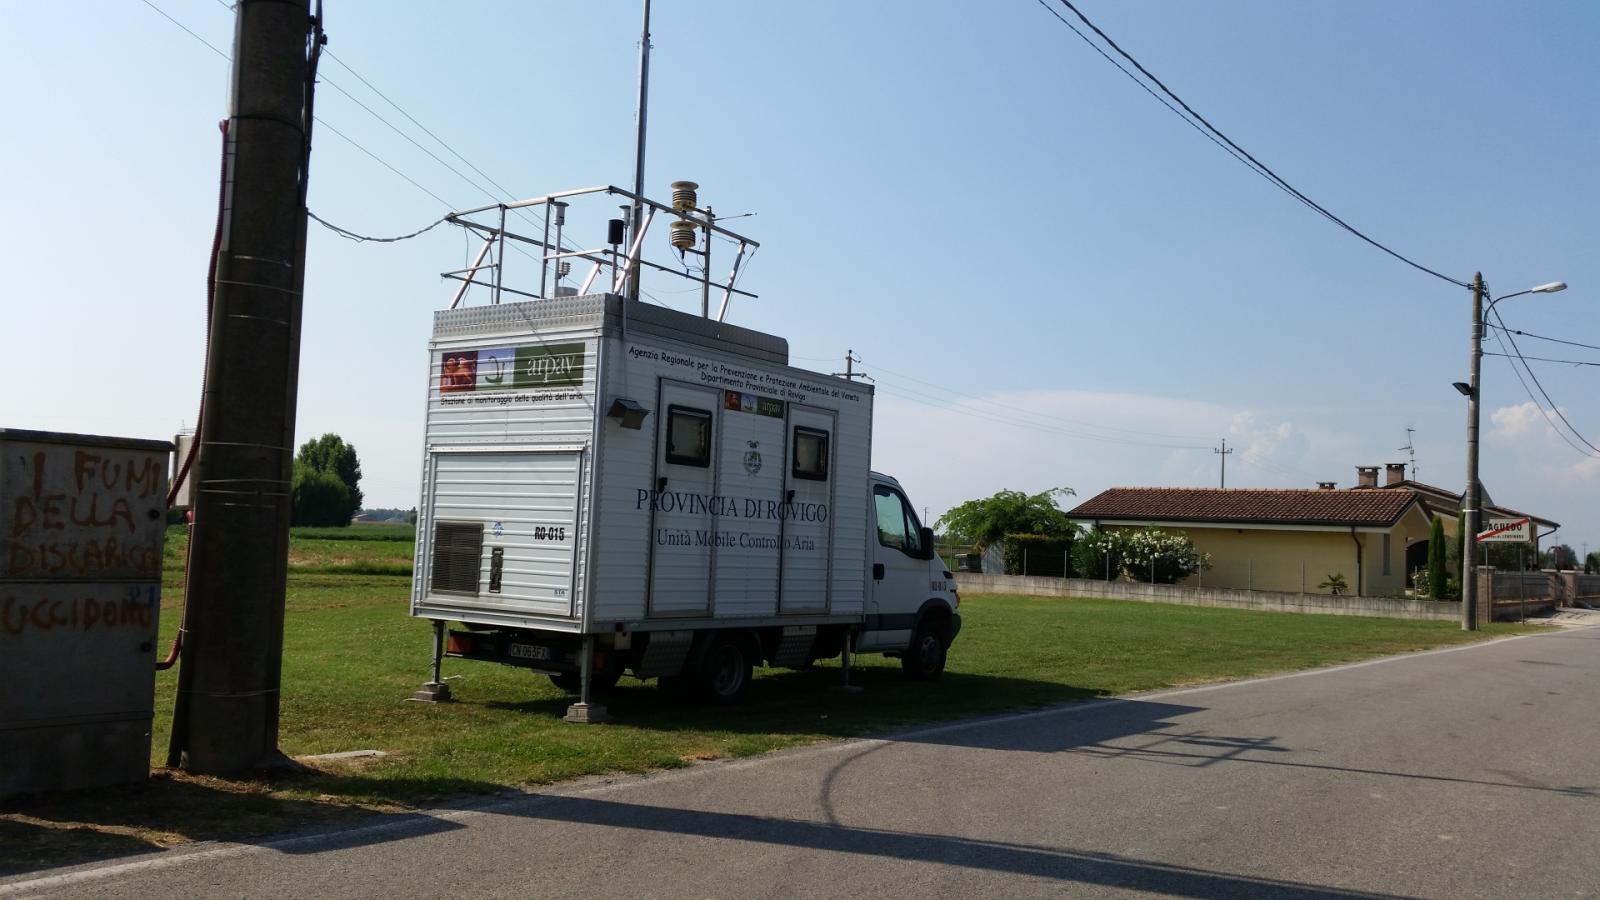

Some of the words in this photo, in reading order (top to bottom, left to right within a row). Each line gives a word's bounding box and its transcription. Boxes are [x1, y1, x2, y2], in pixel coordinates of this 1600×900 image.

[527, 353, 577, 382] arpav
[628, 346, 658, 359] Agenzia
[661, 352, 695, 366] Regionale
[697, 361, 709, 371] per
[711, 361, 718, 373] la
[720, 364, 758, 381] Prevenzione
[759, 375, 764, 383] e
[765, 374, 797, 389] Protezione
[799, 382, 830, 396] Ambientale
[831, 389, 840, 398] del
[841, 391, 860, 402] Veneto
[701, 371, 744, 388] Dipartimento
[745, 380, 778, 395] Provinciale
[779, 388, 786, 397] di
[787, 389, 806, 402] Rovigo
[75, 449, 162, 498] FUMI
[14, 493, 136, 538] DELLA
[637, 488, 738, 518] PROVINCIA
[744, 498, 762, 519] DI
[767, 500, 828, 523] ROVIGO
[657, 528, 692, 546] Unità
[695, 530, 737, 548] Mobile
[739, 532, 791, 550] Controlo
[793, 535, 815, 551] Aria
[1487, 523, 1522, 531] AGUEDO
